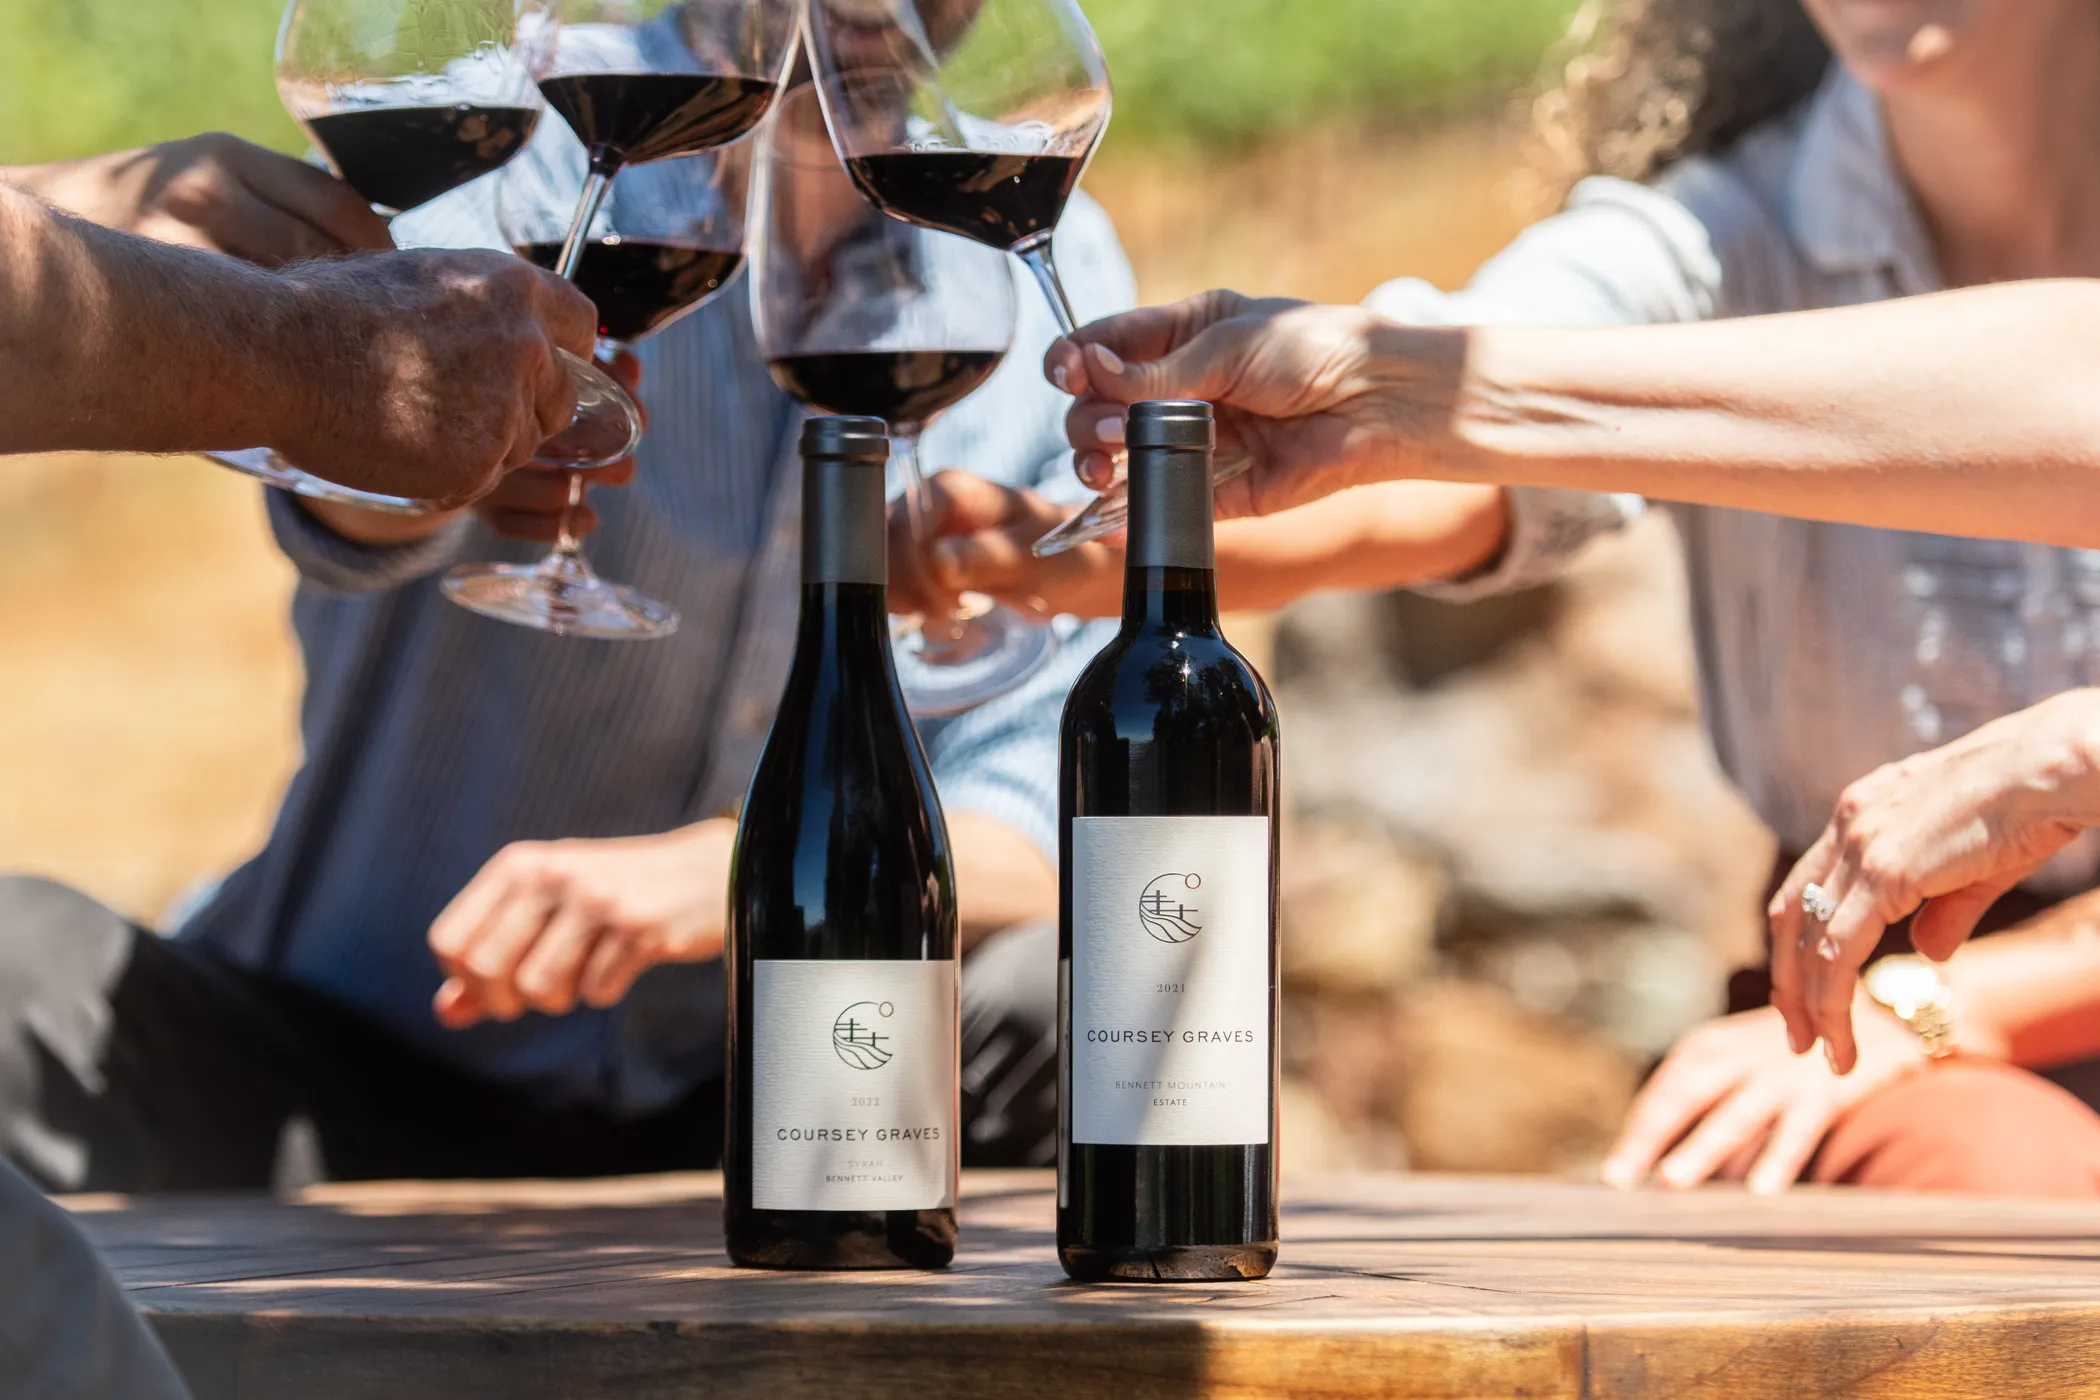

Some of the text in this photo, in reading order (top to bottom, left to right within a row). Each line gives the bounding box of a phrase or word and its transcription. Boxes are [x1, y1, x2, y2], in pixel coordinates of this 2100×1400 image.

[1157, 984, 1185, 993] 2021
[1087, 1030, 1254, 1043] COURSEY GRAVES
[1115, 1081, 1226, 1090] BENNETT MOUNTAIN
[851, 1097, 880, 1107] 2022
[1153, 1098, 1187, 1107] ESTATE
[777, 1127, 940, 1141] COURSEY GRAVES
[848, 1160, 884, 1169] SYRAH
[825, 1175, 903, 1183] BENNETT VALLEY
